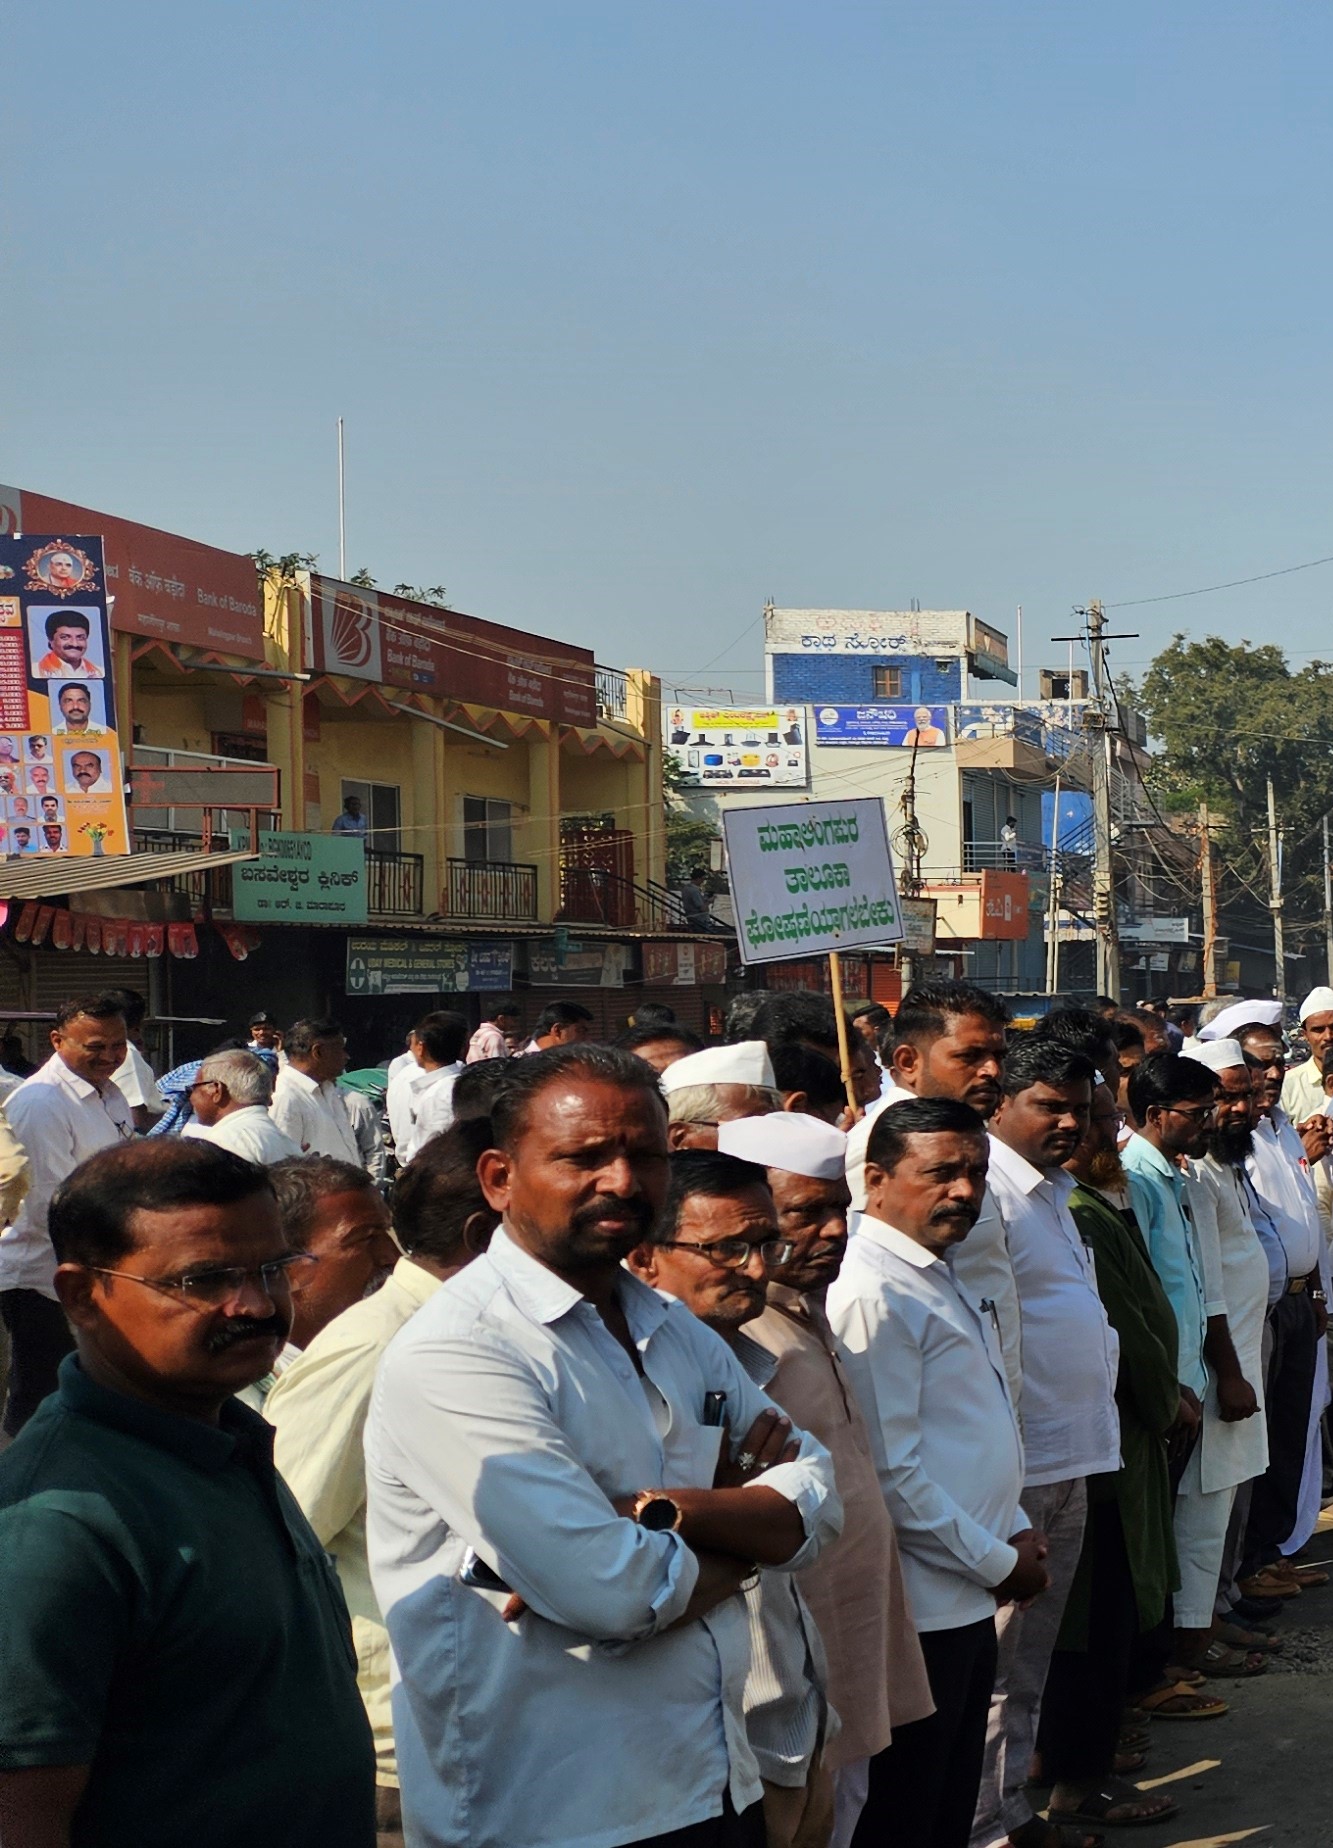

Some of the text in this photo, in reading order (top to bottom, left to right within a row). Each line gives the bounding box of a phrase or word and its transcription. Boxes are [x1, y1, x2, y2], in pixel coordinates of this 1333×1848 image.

[197, 588, 257, 617] Bank of Baroda
[387, 649, 404, 666] Bank
[404, 653, 411, 667] of
[757, 811, 859, 852] ಮಹಾಲಿಂಗಪುರ
[241, 865, 359, 892] ಬಸವೇಶ್ವರ ಕ್ಲಿನಿಕ್
[784, 863, 851, 894] ತಾಲೂಕಾ
